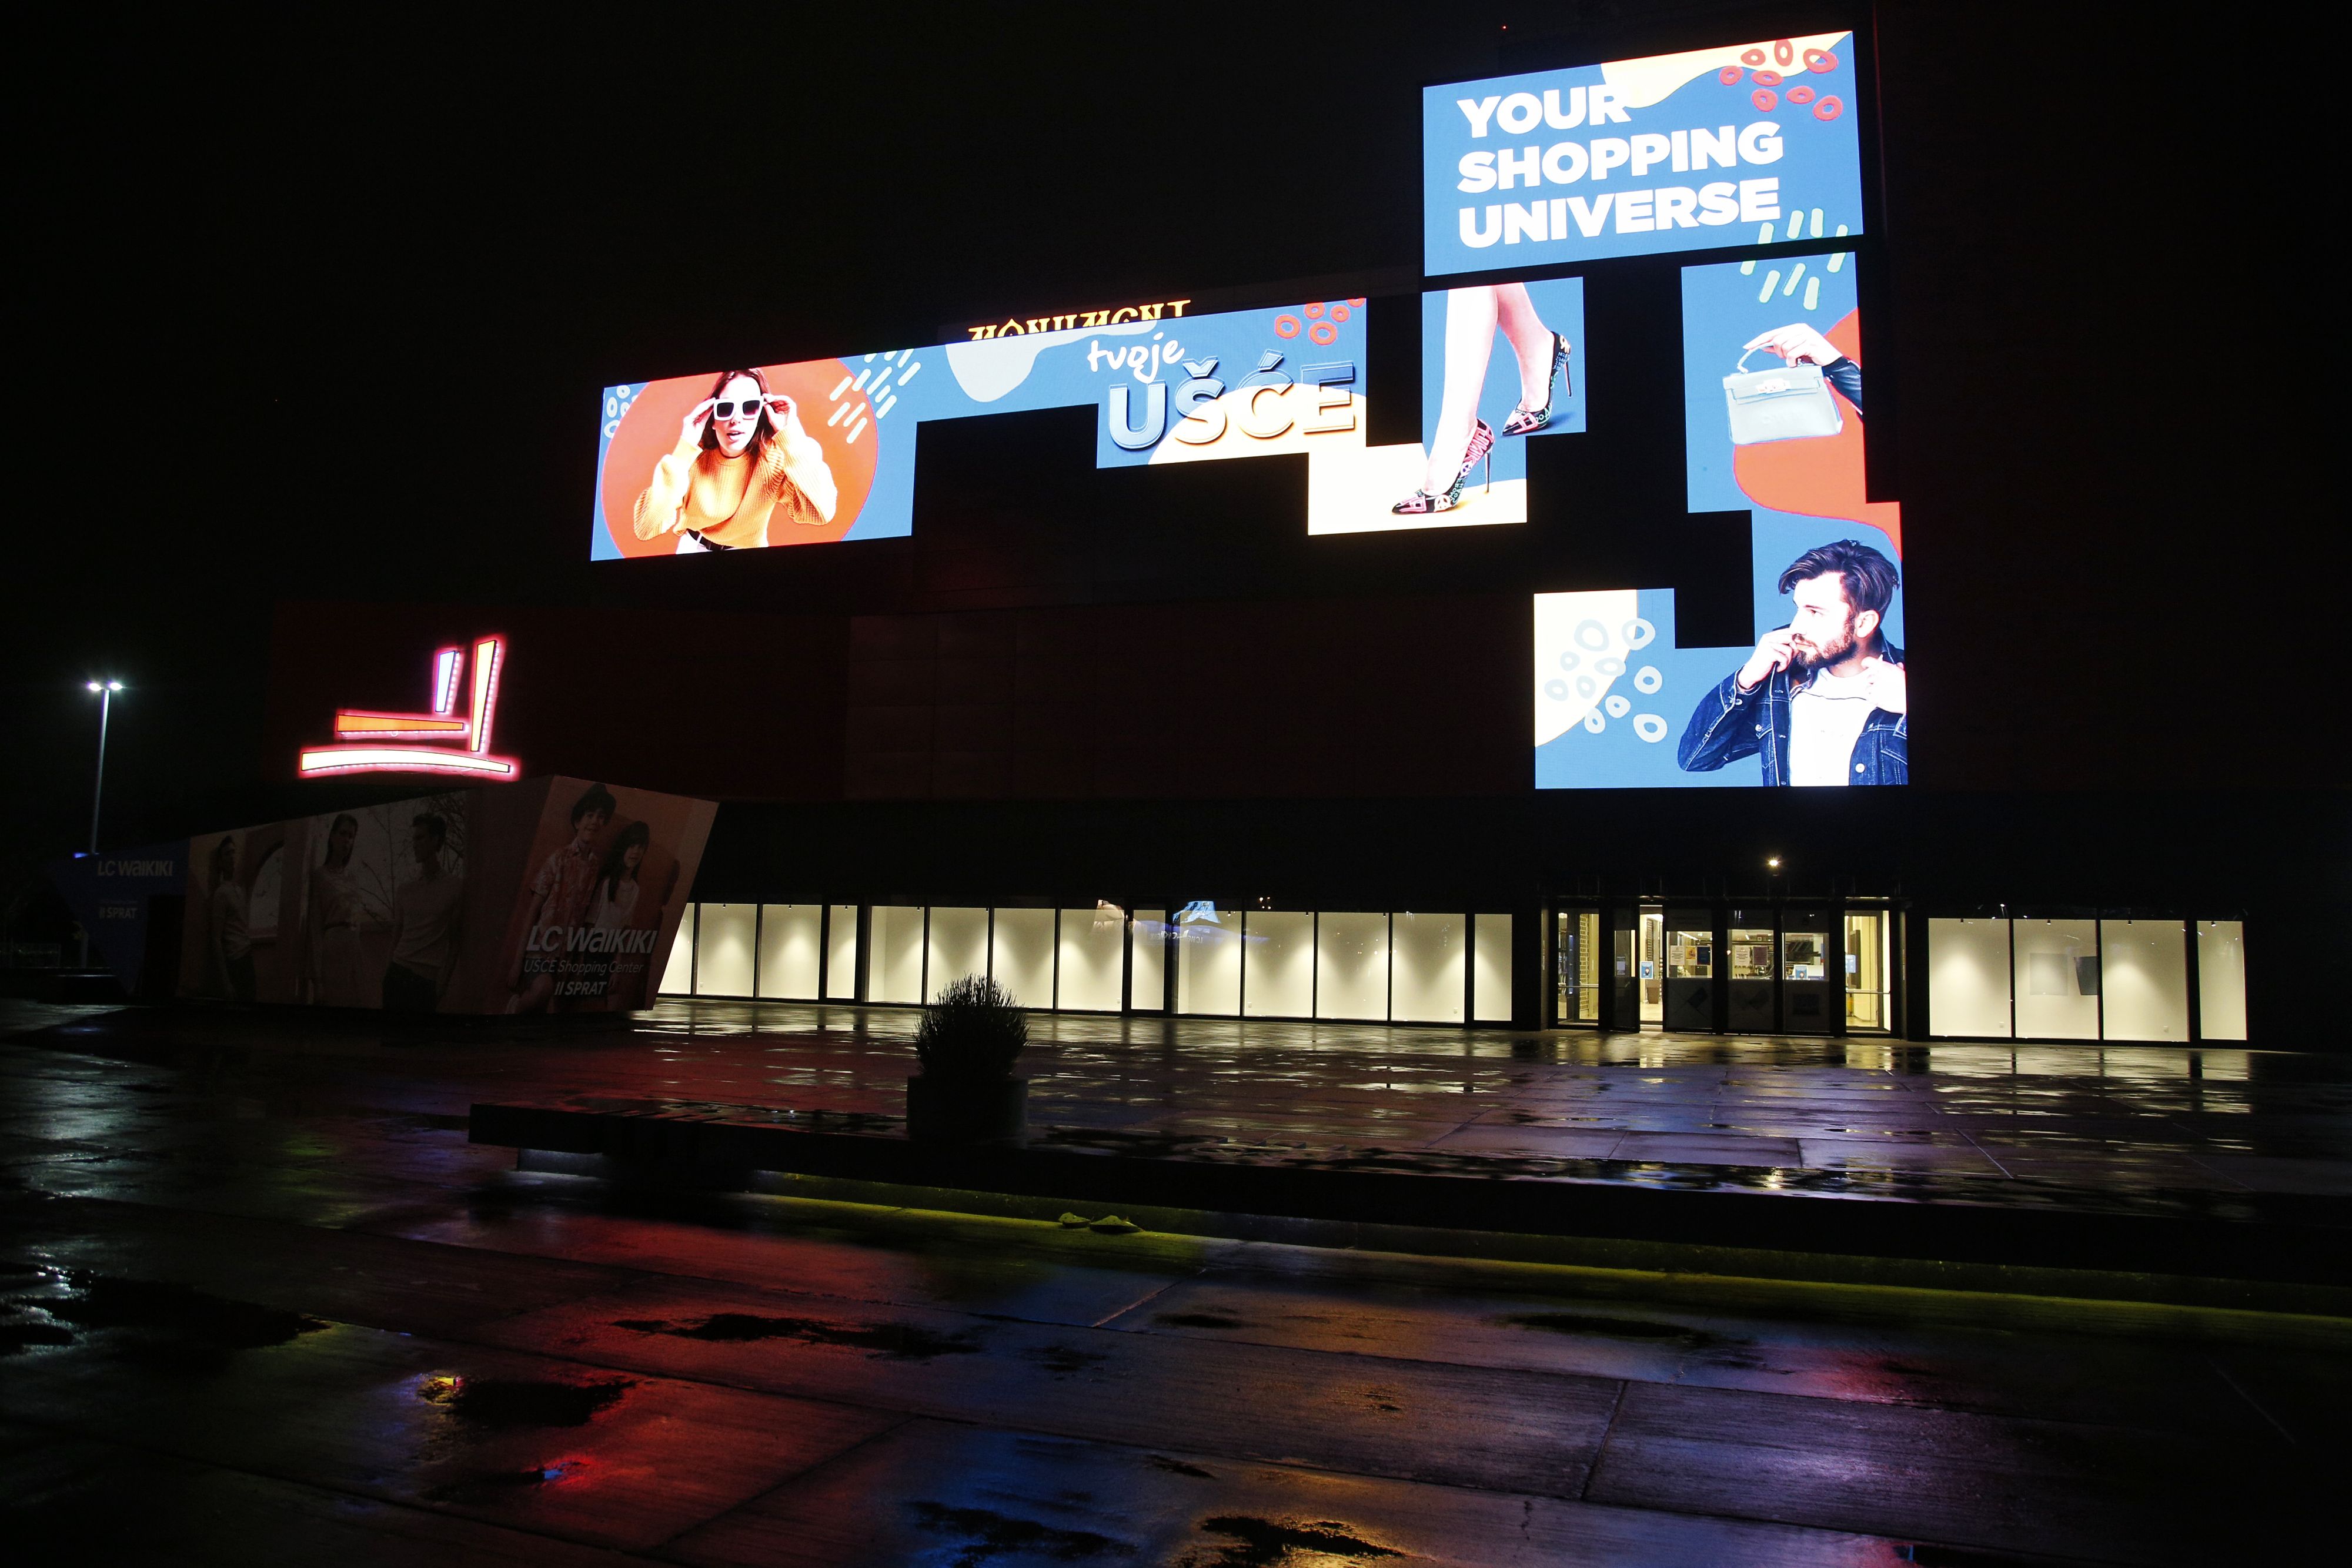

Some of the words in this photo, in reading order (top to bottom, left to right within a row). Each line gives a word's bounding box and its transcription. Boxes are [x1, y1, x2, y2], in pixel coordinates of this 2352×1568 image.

[1456, 83, 1631, 138] YOUR
[1456, 121, 1783, 193] SHOPPING
[1459, 178, 1780, 248] UNIVERSE
[1088, 332, 1185, 383] tvoje
[1108, 349, 1355, 449] UŠĆE
[98, 861, 116, 876] LC
[106, 907, 138, 919] SPRAT
[526, 925, 563, 952] LC
[559, 960, 608, 976] Shopping
[609, 961, 644, 973] Center
[566, 981, 607, 995] SPRAT
